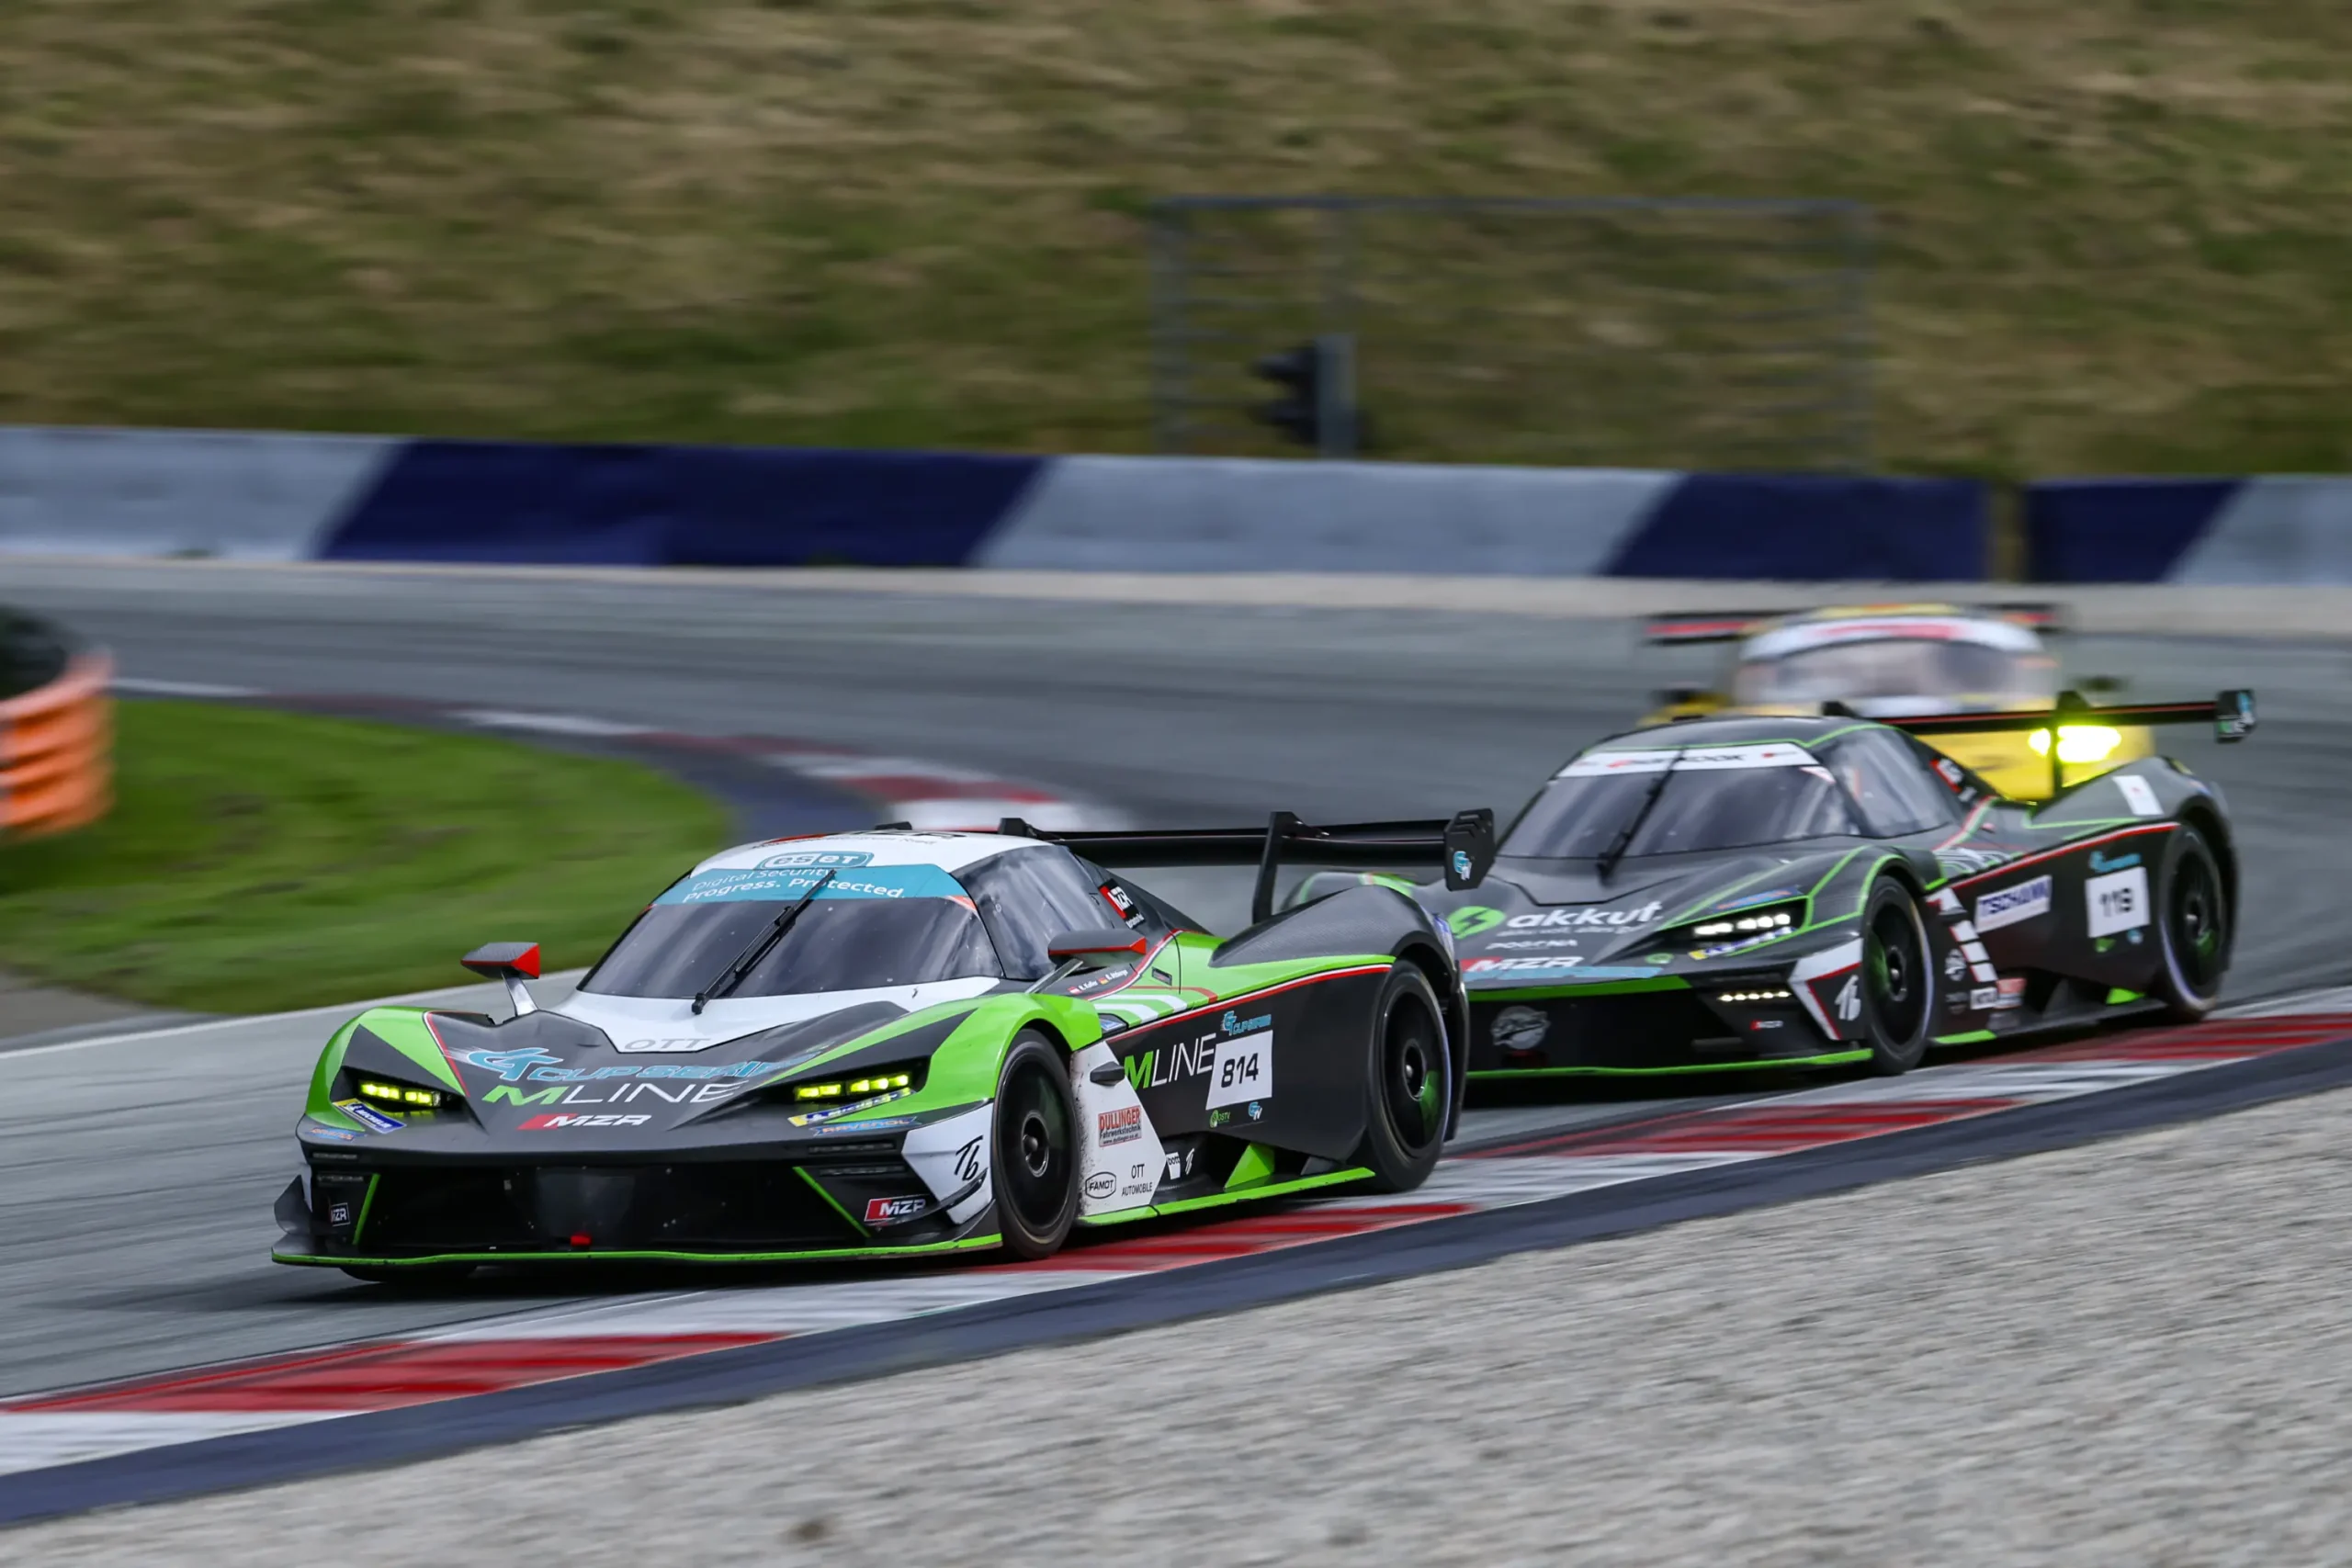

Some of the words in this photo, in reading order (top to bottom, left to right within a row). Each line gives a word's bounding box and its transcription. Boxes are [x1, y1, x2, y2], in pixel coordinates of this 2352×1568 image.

[691, 872, 752, 892] Digital
[755, 867, 831, 879] Security
[624, 1038, 711, 1050] OTT
[1124, 1032, 1216, 1091] MLINE
[1220, 1053, 1259, 1089] 814
[543, 1114, 651, 1128] MZR
[1099, 1108, 1140, 1131] DULLINGER
[1131, 1164, 1145, 1179] OTT
[1089, 1179, 1114, 1191] FAMOT
[1122, 1182, 1153, 1197] AUTOMOBILE
